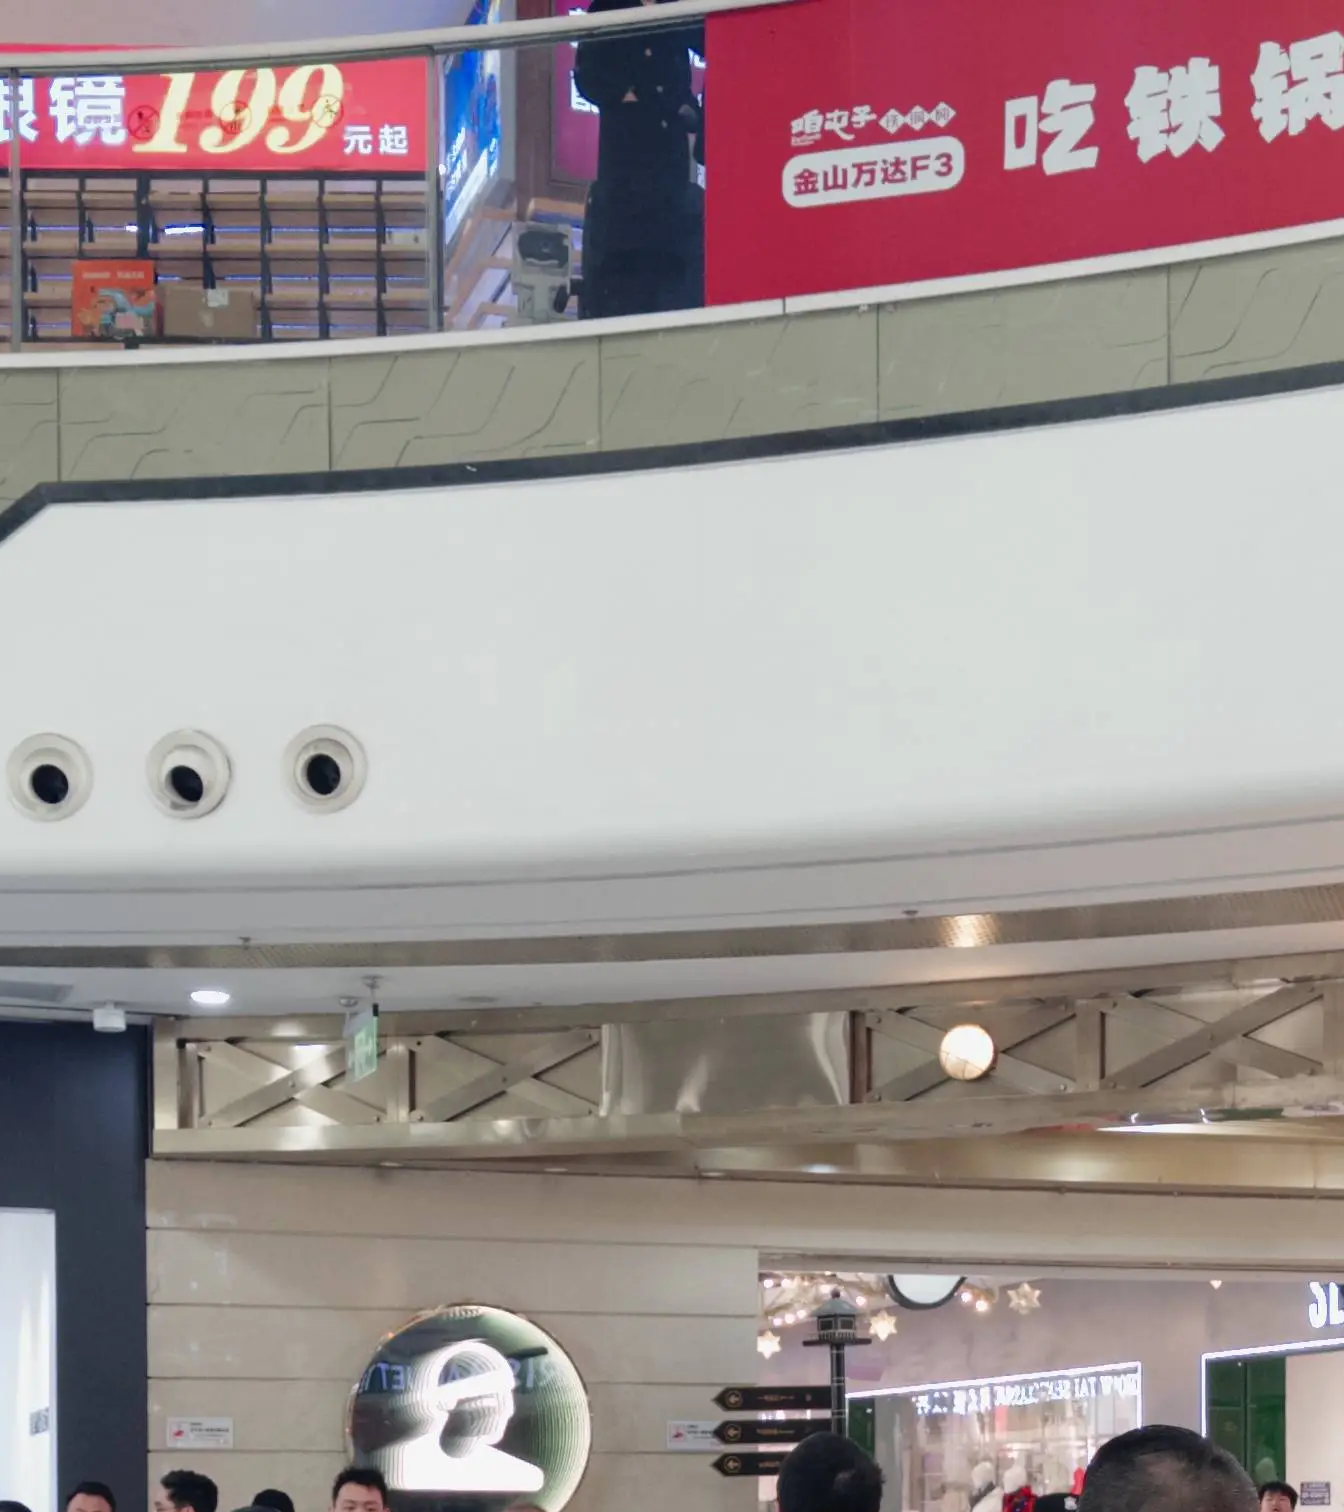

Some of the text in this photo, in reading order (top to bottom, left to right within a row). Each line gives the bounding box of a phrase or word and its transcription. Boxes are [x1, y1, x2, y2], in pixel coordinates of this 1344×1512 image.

[132, 63, 344, 154] 199
[343, 124, 409, 155] 元起
[793, 152, 954, 196] 金山万达F3
